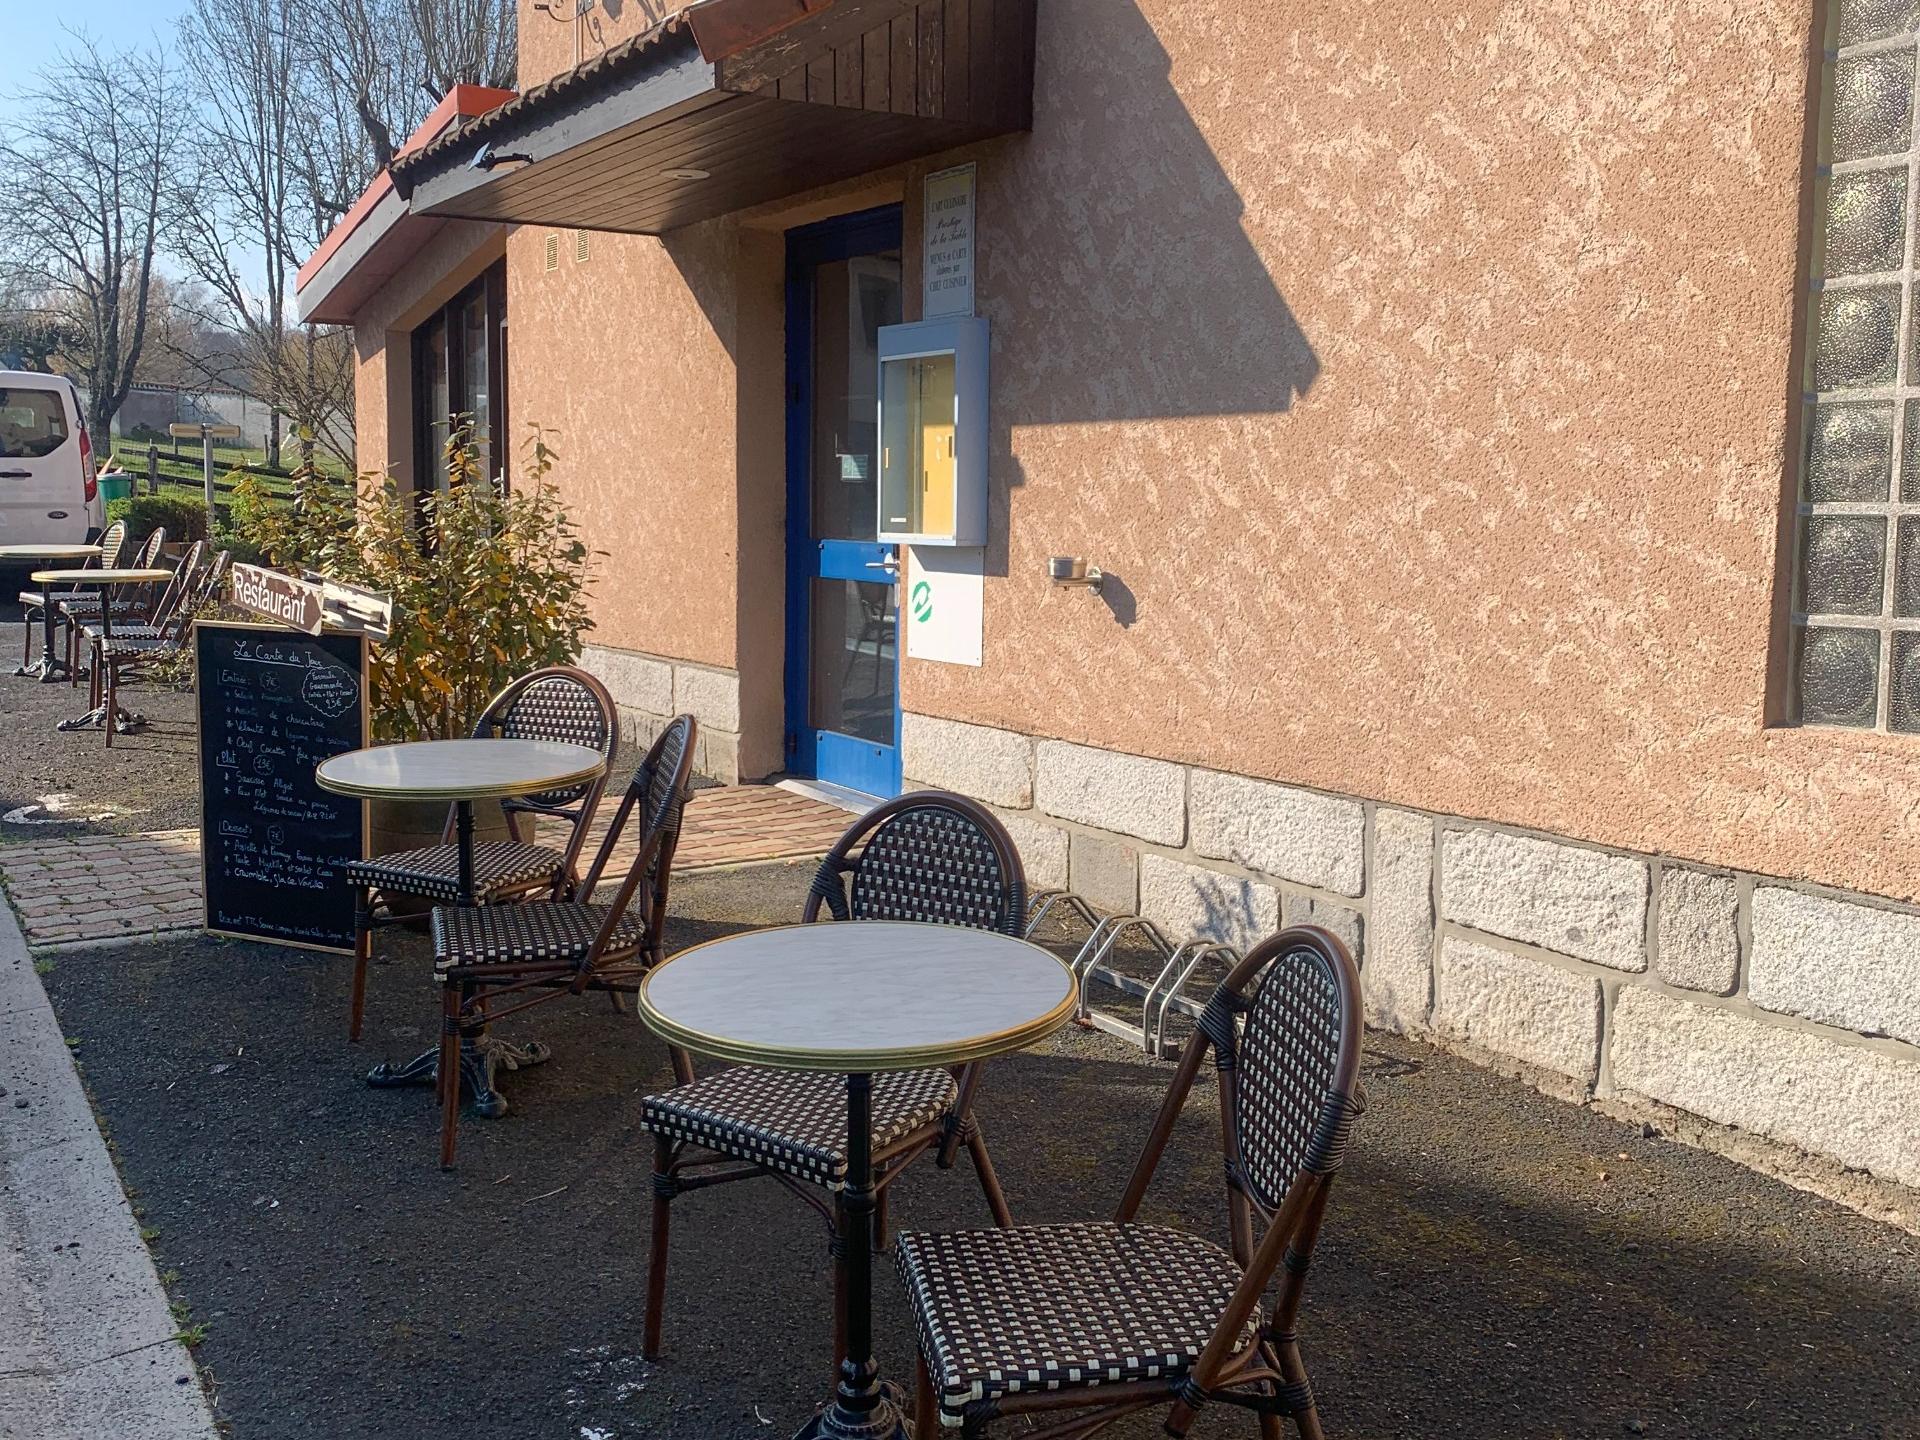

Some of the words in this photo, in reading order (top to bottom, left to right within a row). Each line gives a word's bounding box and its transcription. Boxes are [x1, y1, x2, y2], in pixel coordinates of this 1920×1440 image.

[233, 572, 307, 625] Restaurant
[255, 644, 284, 661] Carte
[289, 650, 301, 663] du
